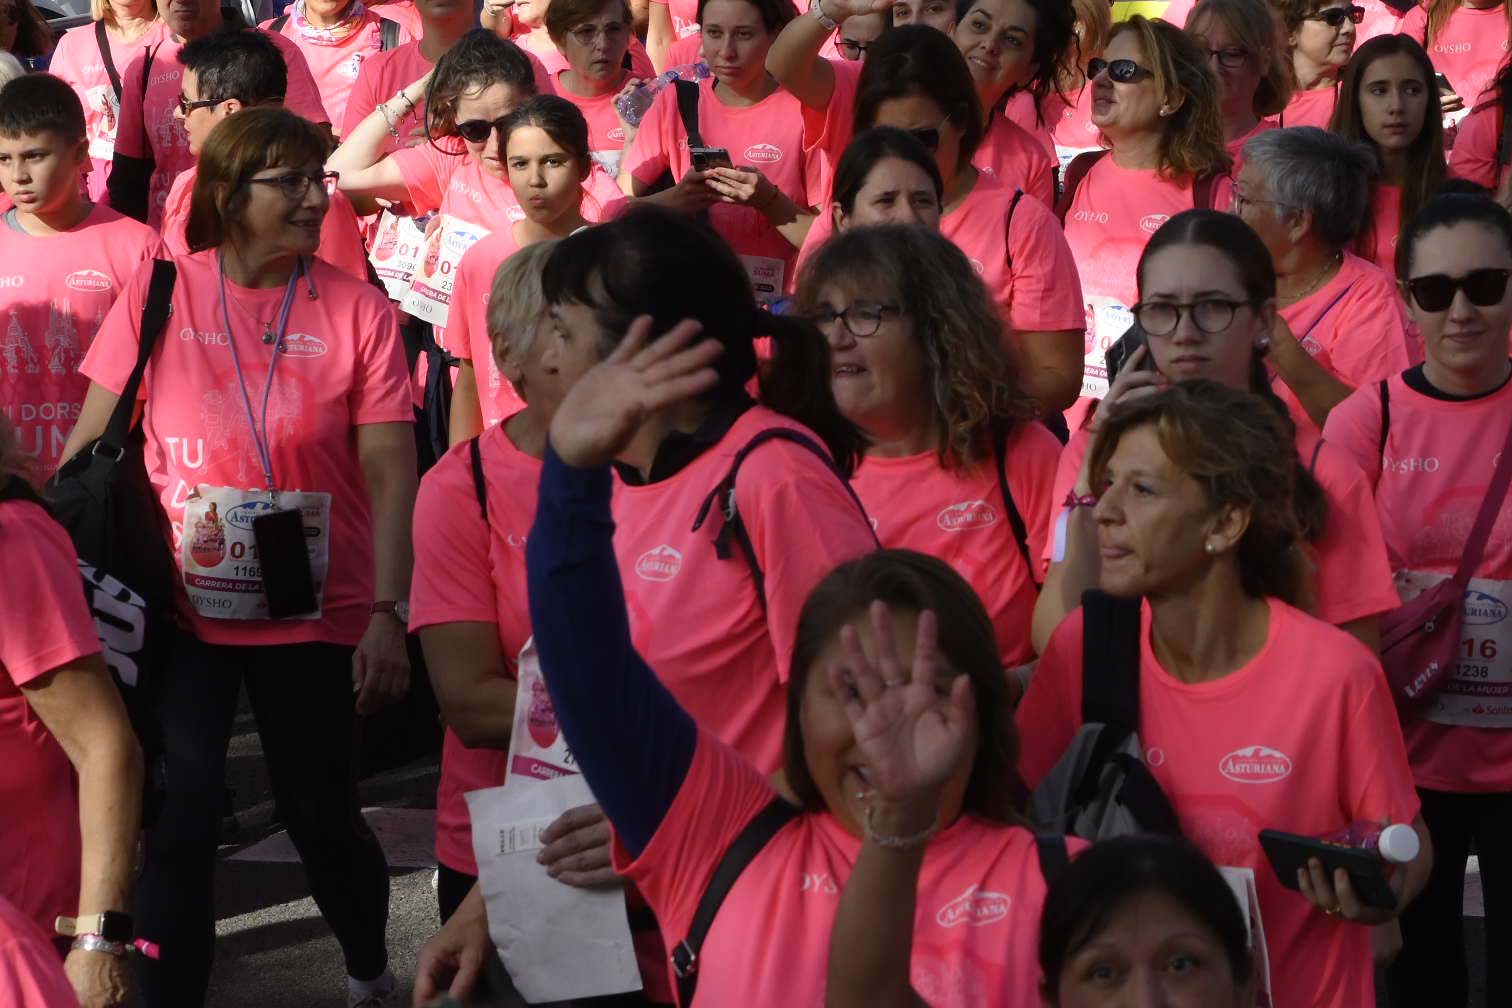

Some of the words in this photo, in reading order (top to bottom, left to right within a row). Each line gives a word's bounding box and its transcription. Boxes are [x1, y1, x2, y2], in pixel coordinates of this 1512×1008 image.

[1434, 42, 1471, 54] OYSHO
[399, 244, 419, 259] 01
[165, 437, 204, 469] TU
[231, 542, 258, 560] 01
[1462, 638, 1497, 660] 16
[1225, 755, 1287, 776] ASTURIANA
